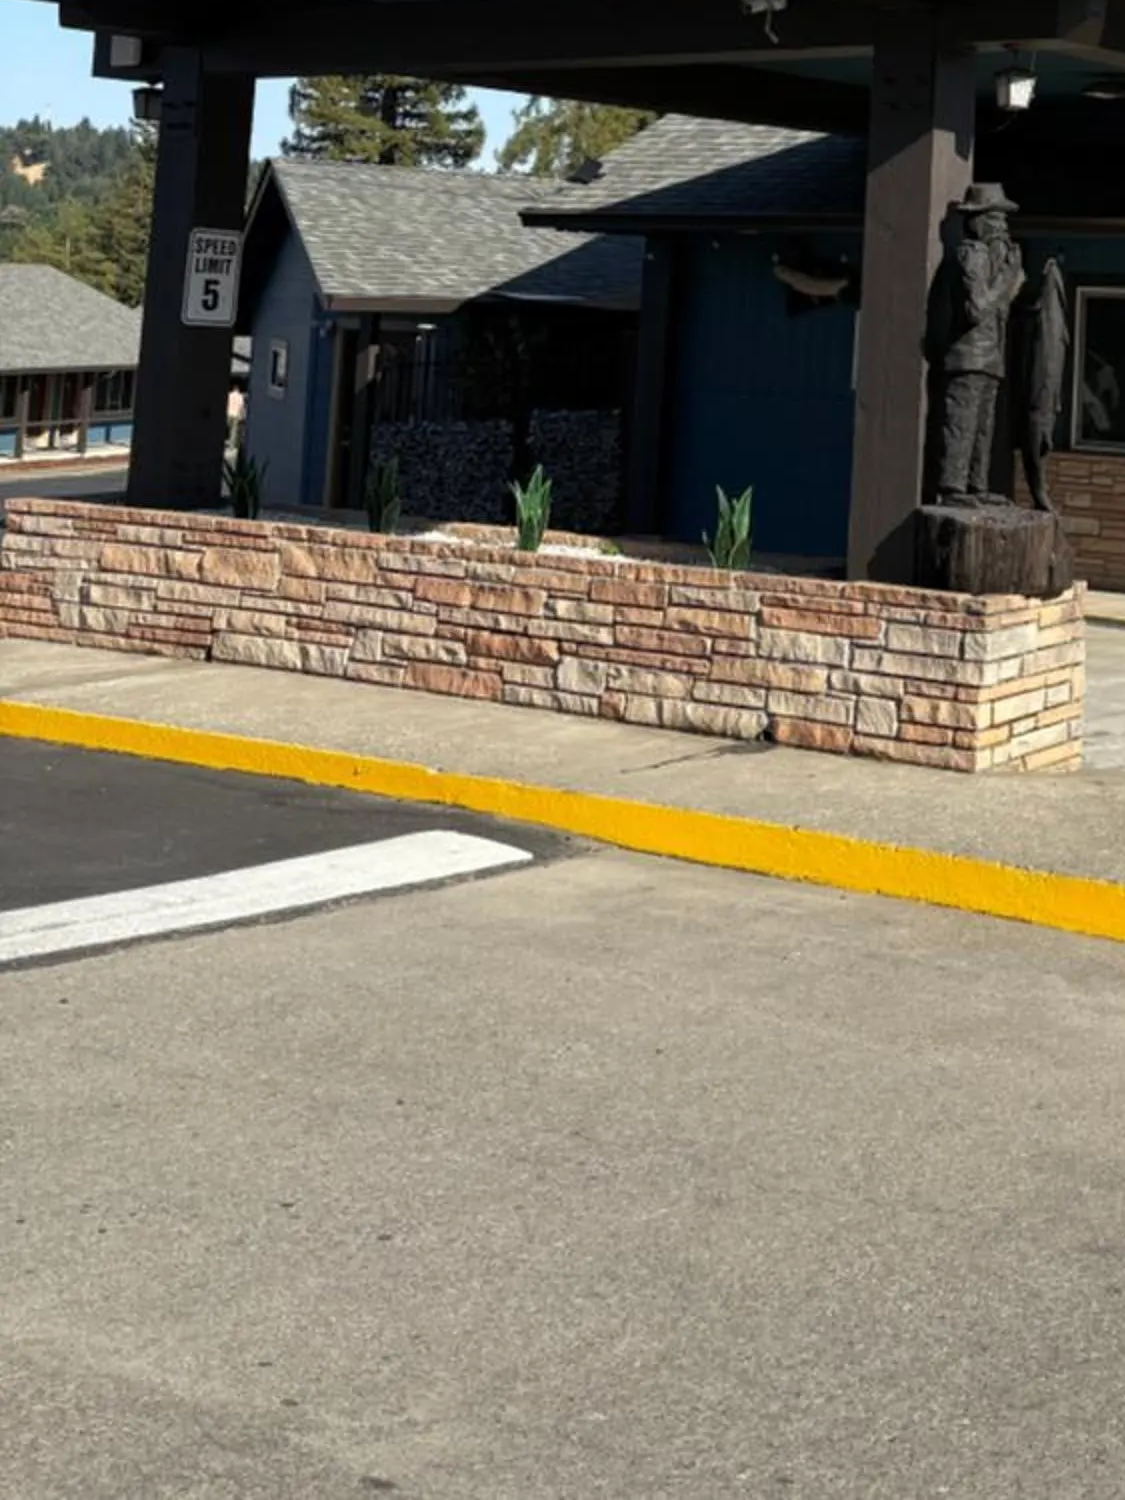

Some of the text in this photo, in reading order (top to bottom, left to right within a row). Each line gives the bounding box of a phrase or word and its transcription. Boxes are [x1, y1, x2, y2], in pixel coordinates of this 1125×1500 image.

[194, 238, 237, 256] SPEED
[195, 257, 231, 276] LIMIT
[201, 279, 220, 311] 5
